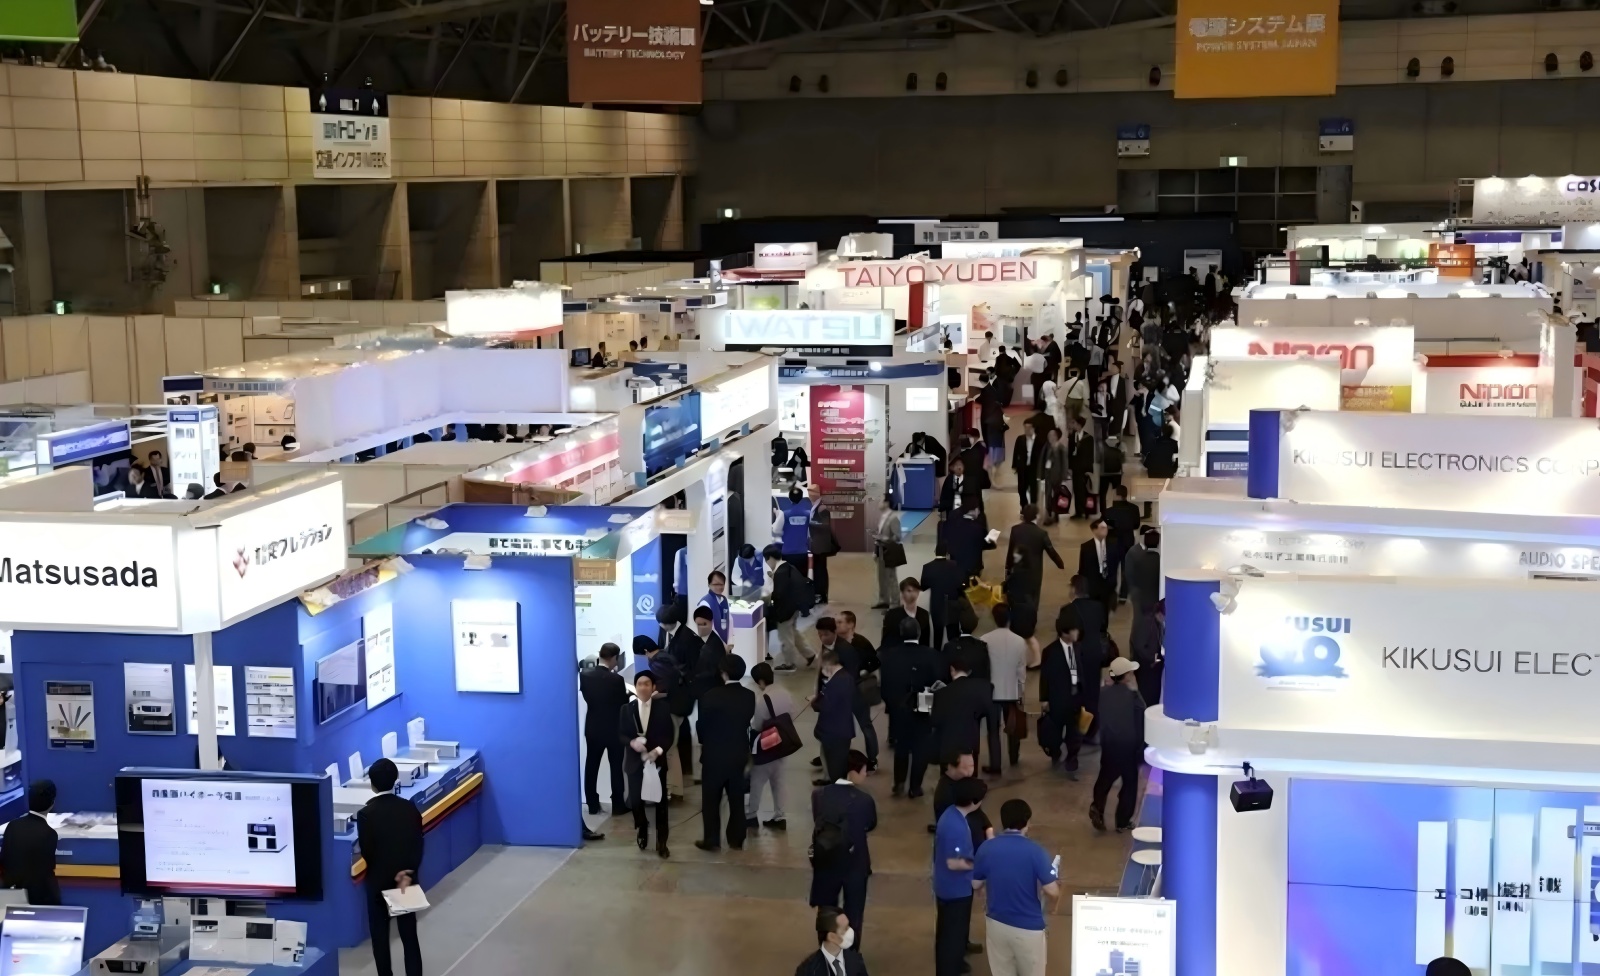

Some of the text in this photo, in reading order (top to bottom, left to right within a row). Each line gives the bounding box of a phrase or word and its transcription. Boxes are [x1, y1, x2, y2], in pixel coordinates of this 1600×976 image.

[838, 260, 1038, 287] TAIYO YUDEN
[725, 314, 882, 340] IWATSU
[1381, 451, 1529, 473] ELECTRONICS
[1382, 646, 1502, 672] KIKUSUI
